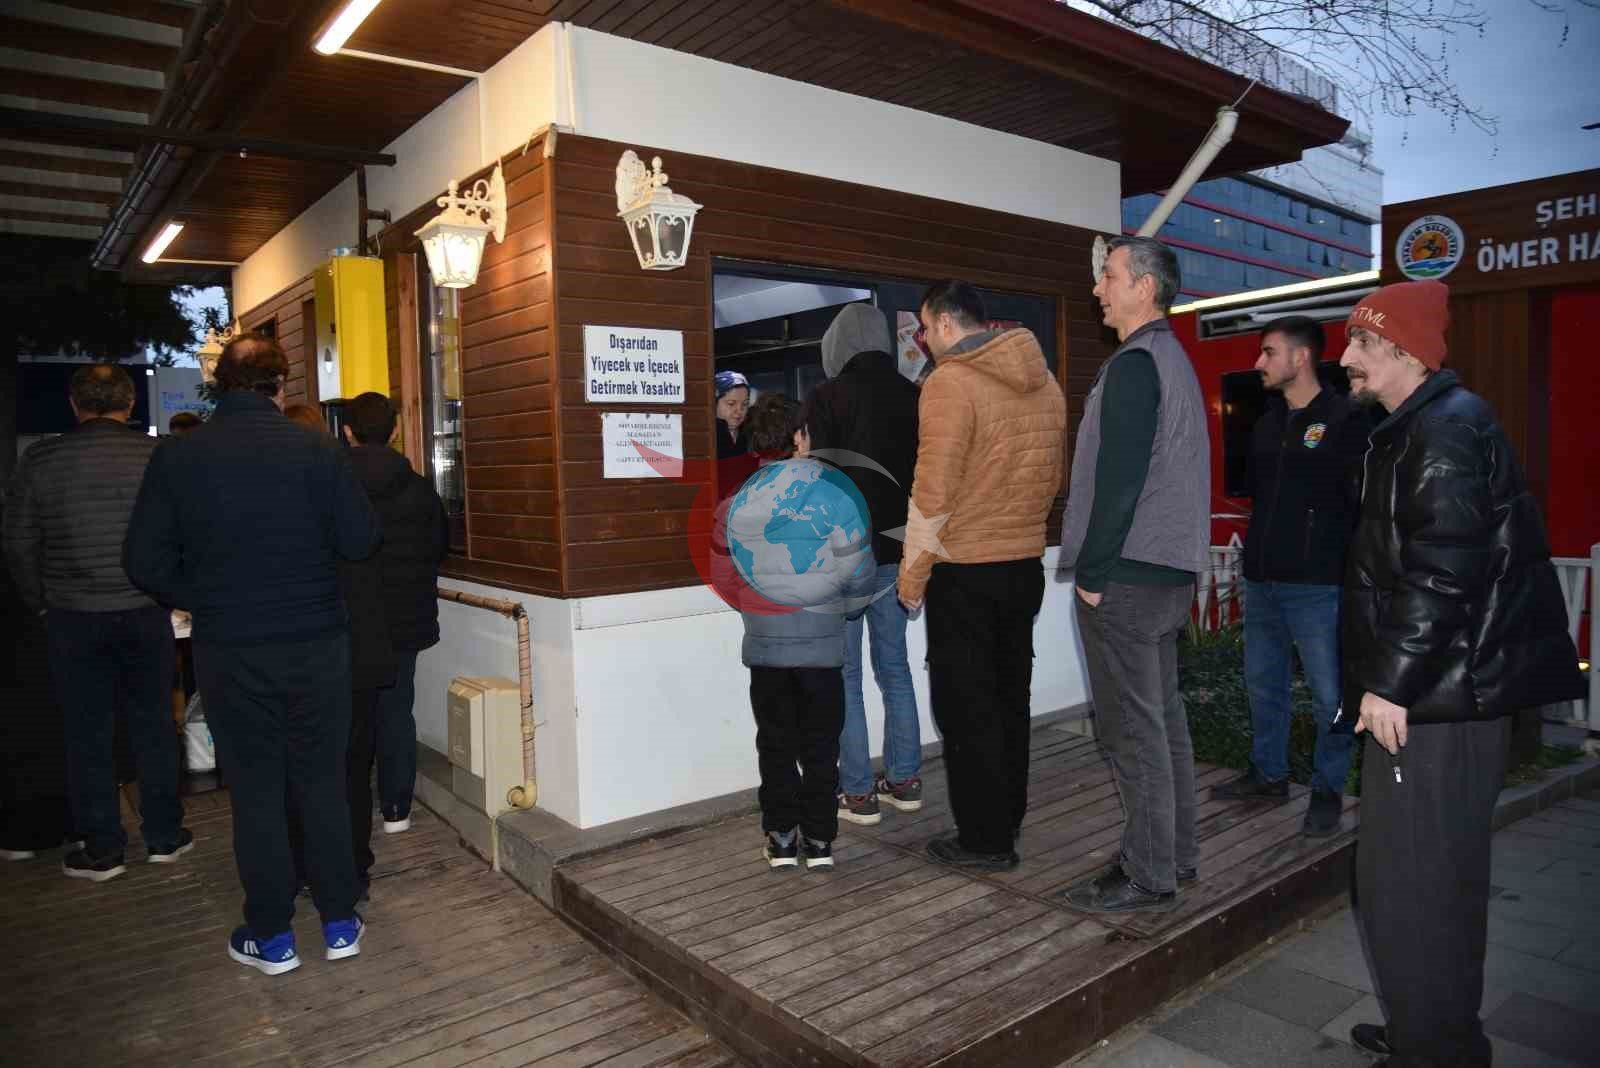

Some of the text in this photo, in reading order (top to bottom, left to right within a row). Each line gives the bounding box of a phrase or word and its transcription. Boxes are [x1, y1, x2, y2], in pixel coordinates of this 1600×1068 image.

[1477, 237, 1560, 272] ÖMER
[609, 333, 658, 353] Dışarıdan
[591, 354, 680, 377] Yiyecek ve İçecek
[591, 379, 681, 395] Getirmek Yasaktır
